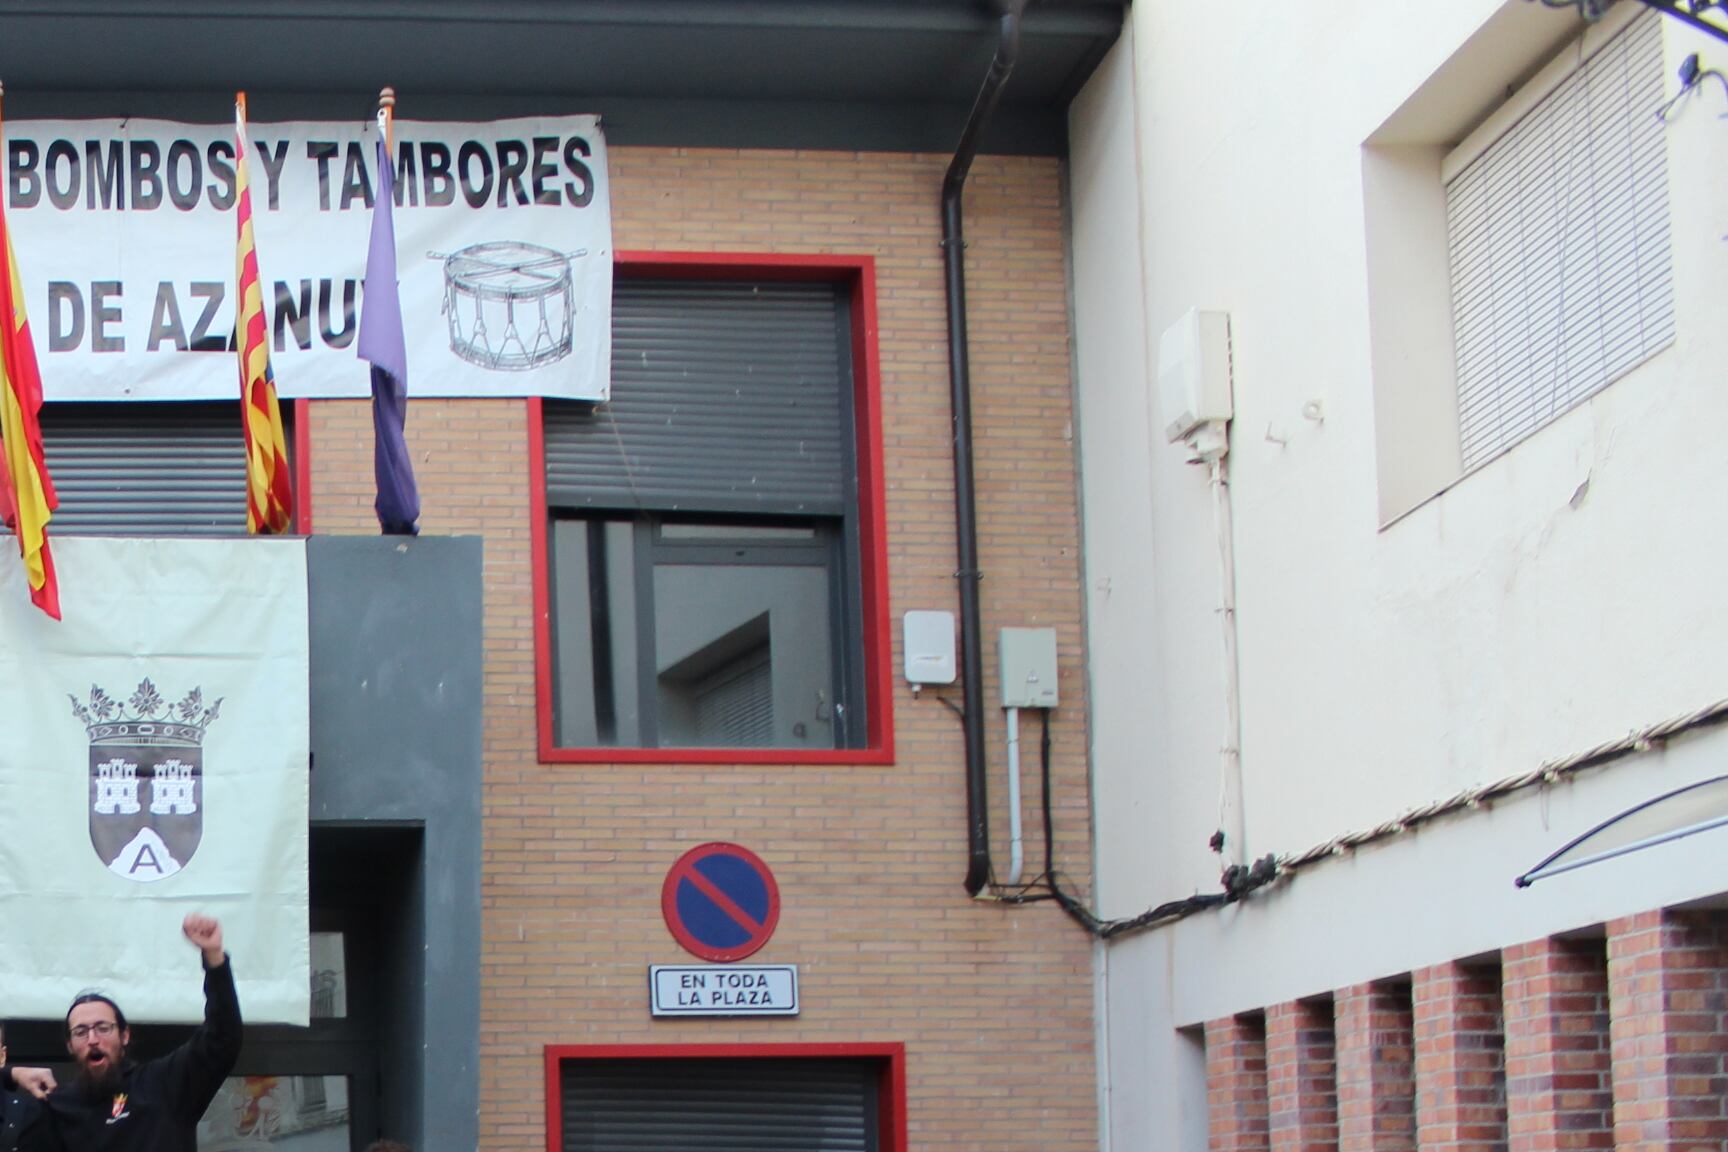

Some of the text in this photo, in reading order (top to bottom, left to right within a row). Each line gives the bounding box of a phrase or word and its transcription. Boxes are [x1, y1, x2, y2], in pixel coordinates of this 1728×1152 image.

[8, 138, 237, 212] BOMBOS
[254, 140, 290, 211] Y
[307, 136, 595, 211] TAMBORES
[47, 281, 126, 353] DE
[146, 278, 399, 352] AZNU
[128, 843, 164, 874] A
[681, 974, 769, 989] EN TODA
[678, 990, 773, 1006] LA PLAZA
